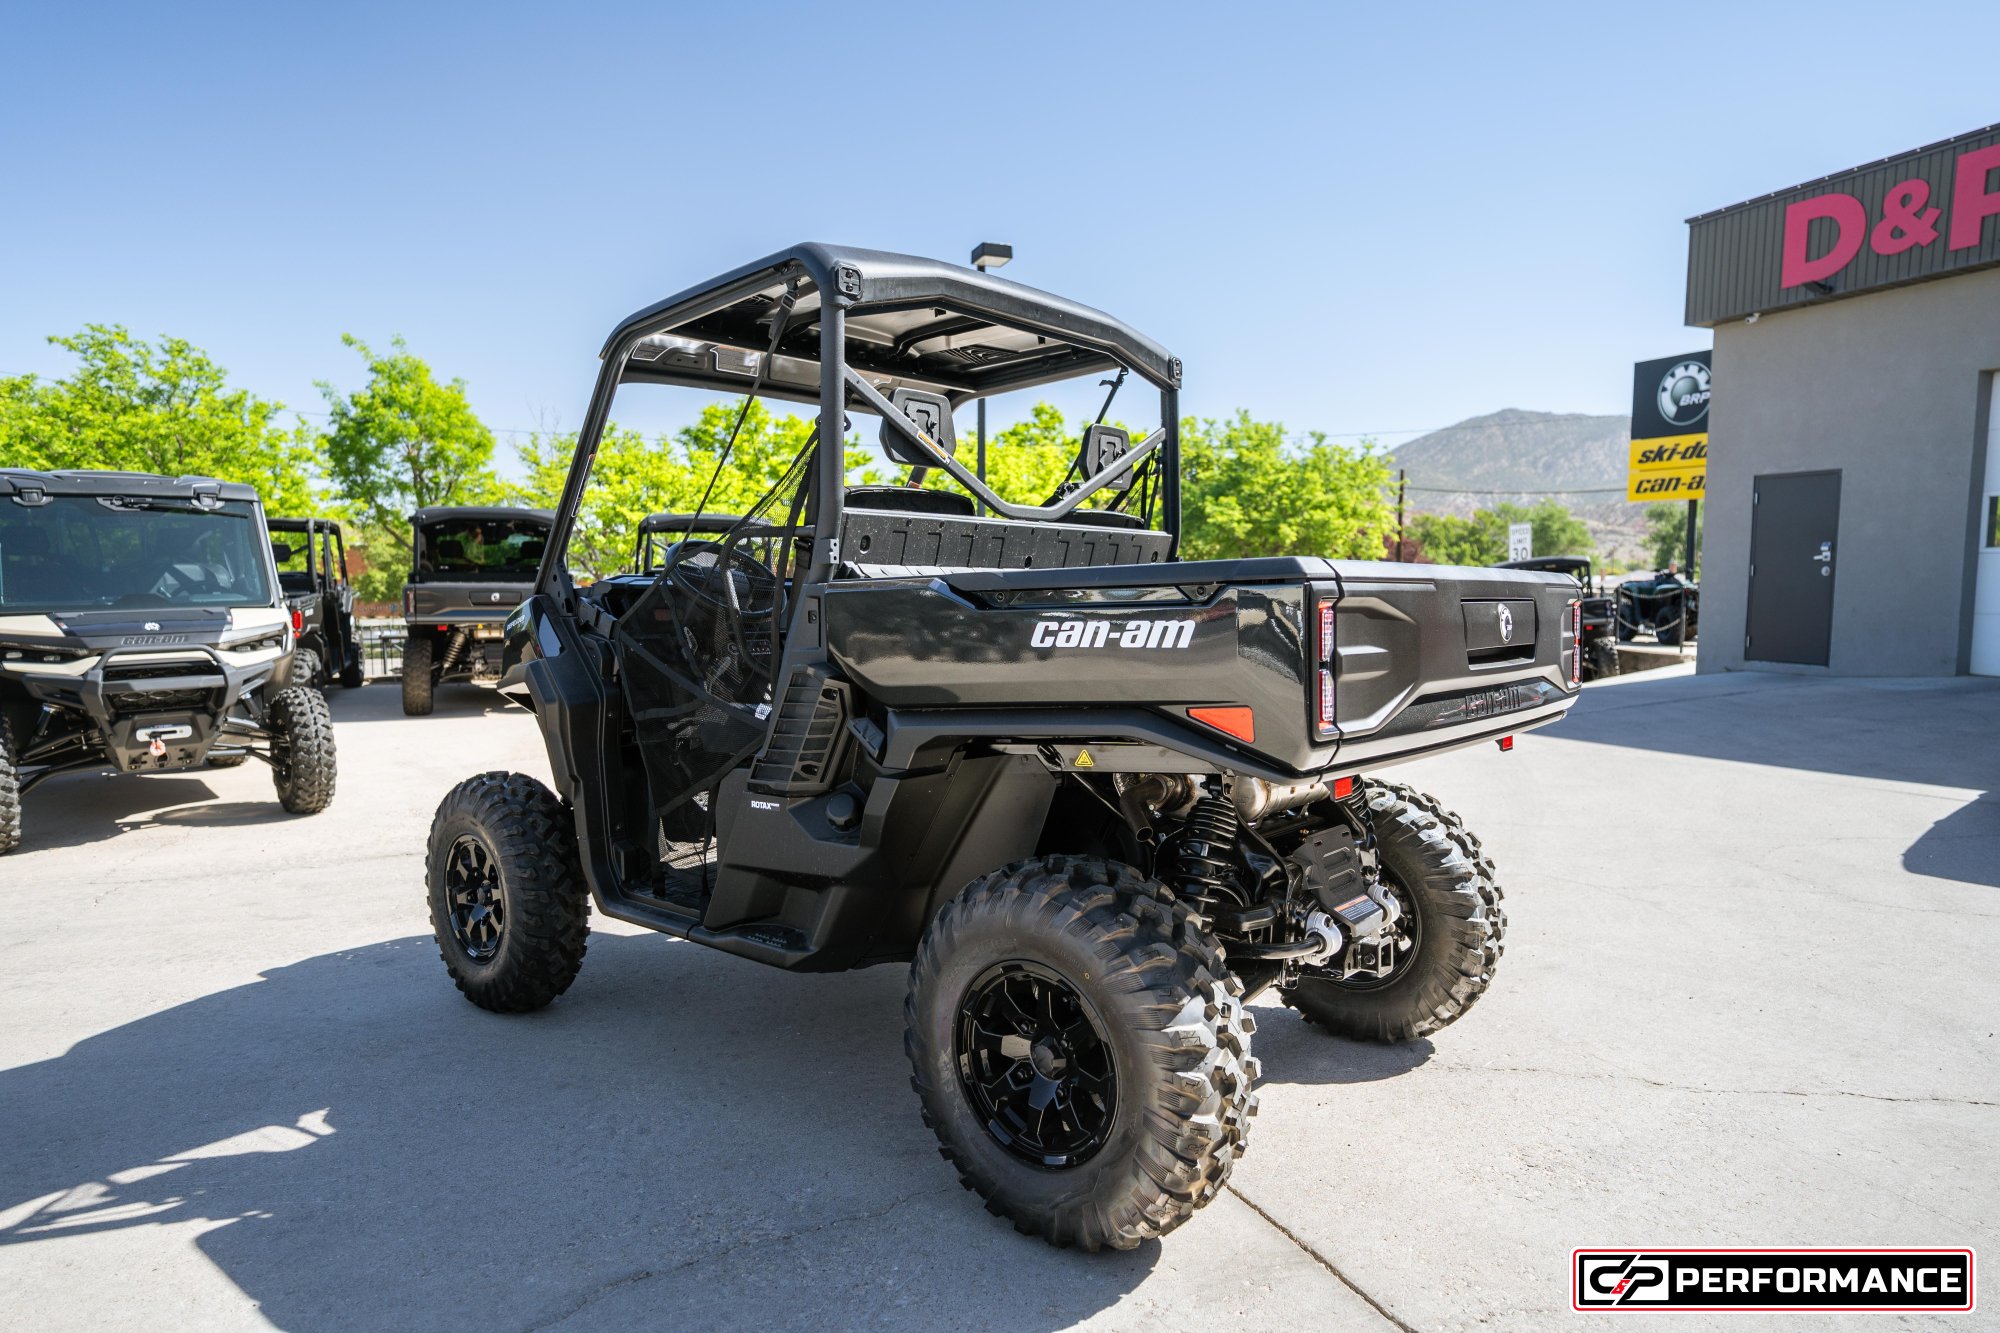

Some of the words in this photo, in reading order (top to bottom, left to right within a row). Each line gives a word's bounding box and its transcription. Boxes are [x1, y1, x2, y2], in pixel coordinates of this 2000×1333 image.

[1679, 391, 1711, 406] BRP
[1638, 440, 1708, 464] ski-do
[1635, 474, 1706, 494] can-a
[1031, 619, 1196, 649] can-am
[751, 800, 772, 810] ROTAX
